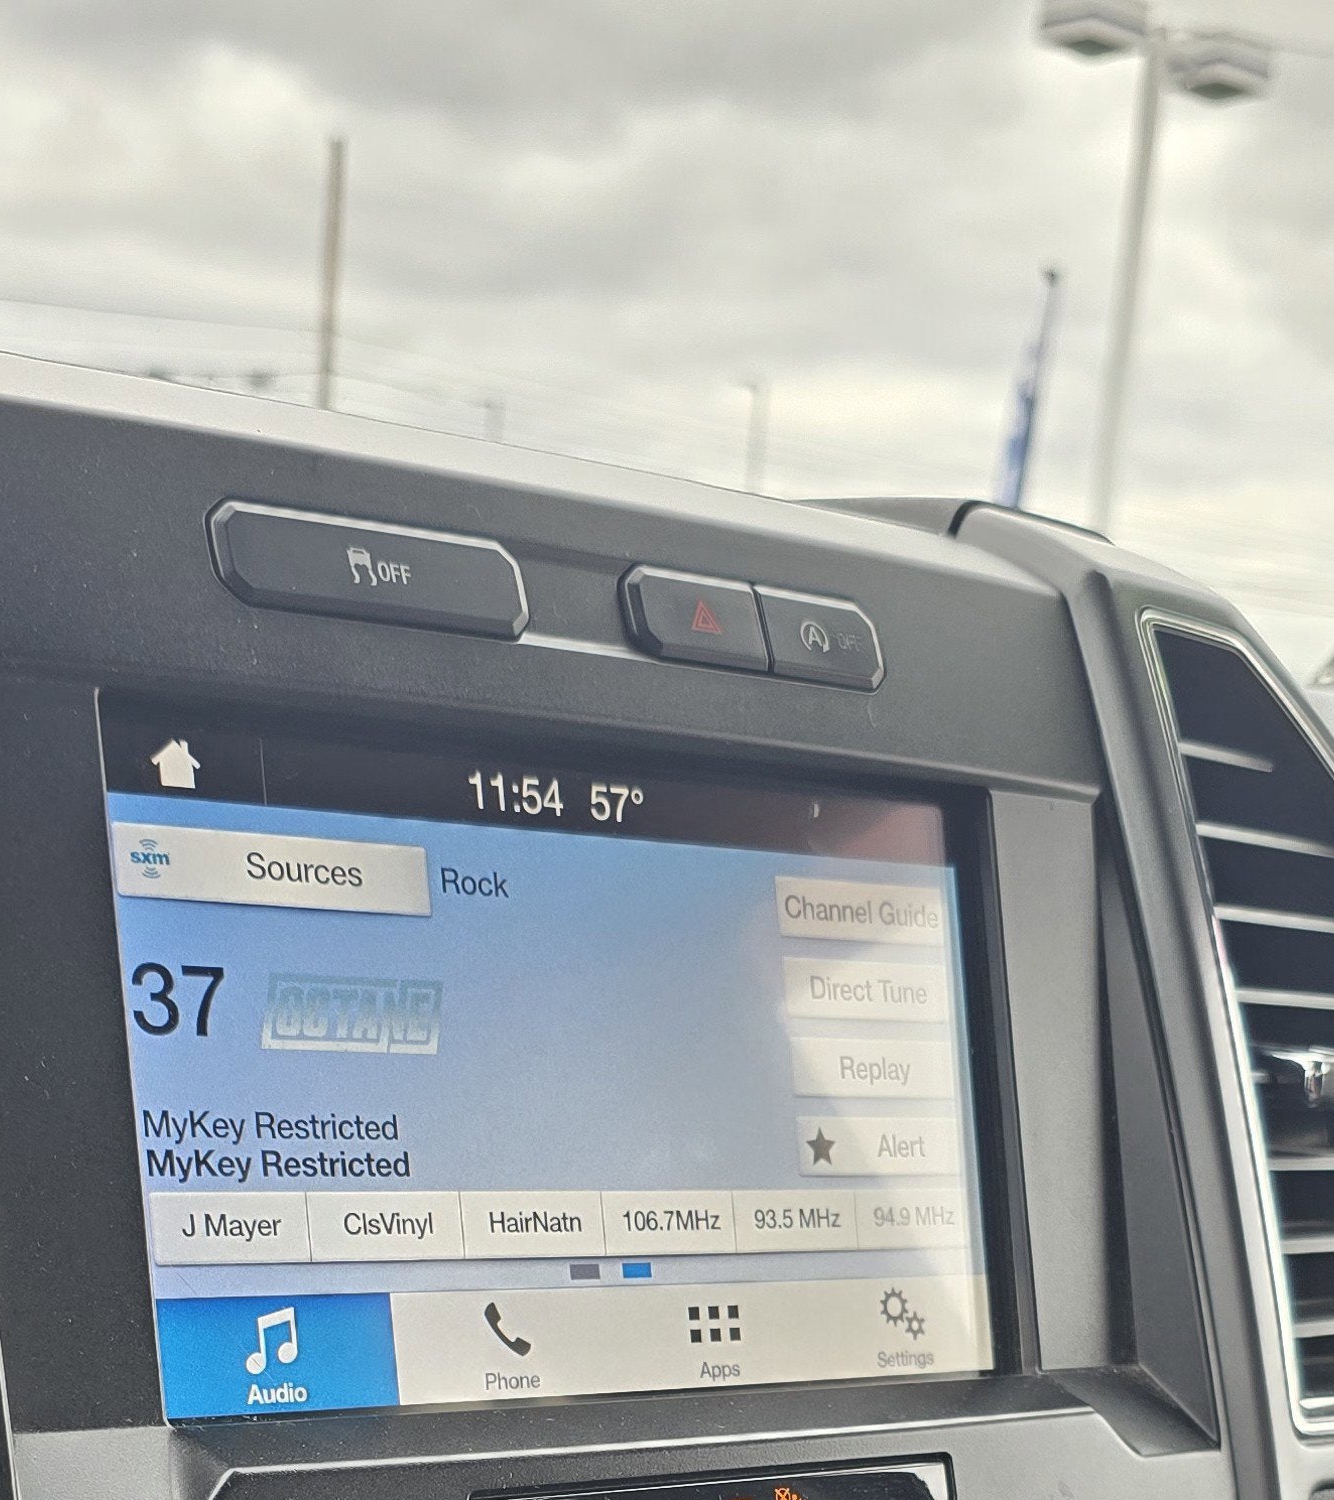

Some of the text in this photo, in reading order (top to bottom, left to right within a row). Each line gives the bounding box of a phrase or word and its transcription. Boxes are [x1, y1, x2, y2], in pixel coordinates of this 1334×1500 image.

[377, 561, 411, 585] OFF
[468, 770, 564, 817] 11:54
[130, 850, 170, 866] sxm
[246, 852, 363, 887] Sources
[440, 867, 509, 899] Rock
[784, 894, 939, 929] Channel Guide
[131, 961, 225, 1037] 37
[809, 975, 928, 1005] Direct Tune
[839, 1055, 911, 1085] Replay
[143, 1109, 399, 1145] MyKey Restricted
[877, 1134, 926, 1159] Alert
[146, 1149, 411, 1183] MyKey Restricted
[182, 1214, 282, 1242] J Mayer
[343, 1212, 435, 1240] ClsVinyl
[489, 1211, 583, 1234] HairNatn
[623, 1210, 721, 1232] 106.7MHz
[754, 1209, 841, 1230] 93.5 MHz
[873, 1206, 956, 1227] 94.9 MHz
[700, 1361, 741, 1380] Apps
[877, 1351, 934, 1370] Settings
[247, 1383, 308, 1406] Audio
[485, 1373, 540, 1390] Phone
